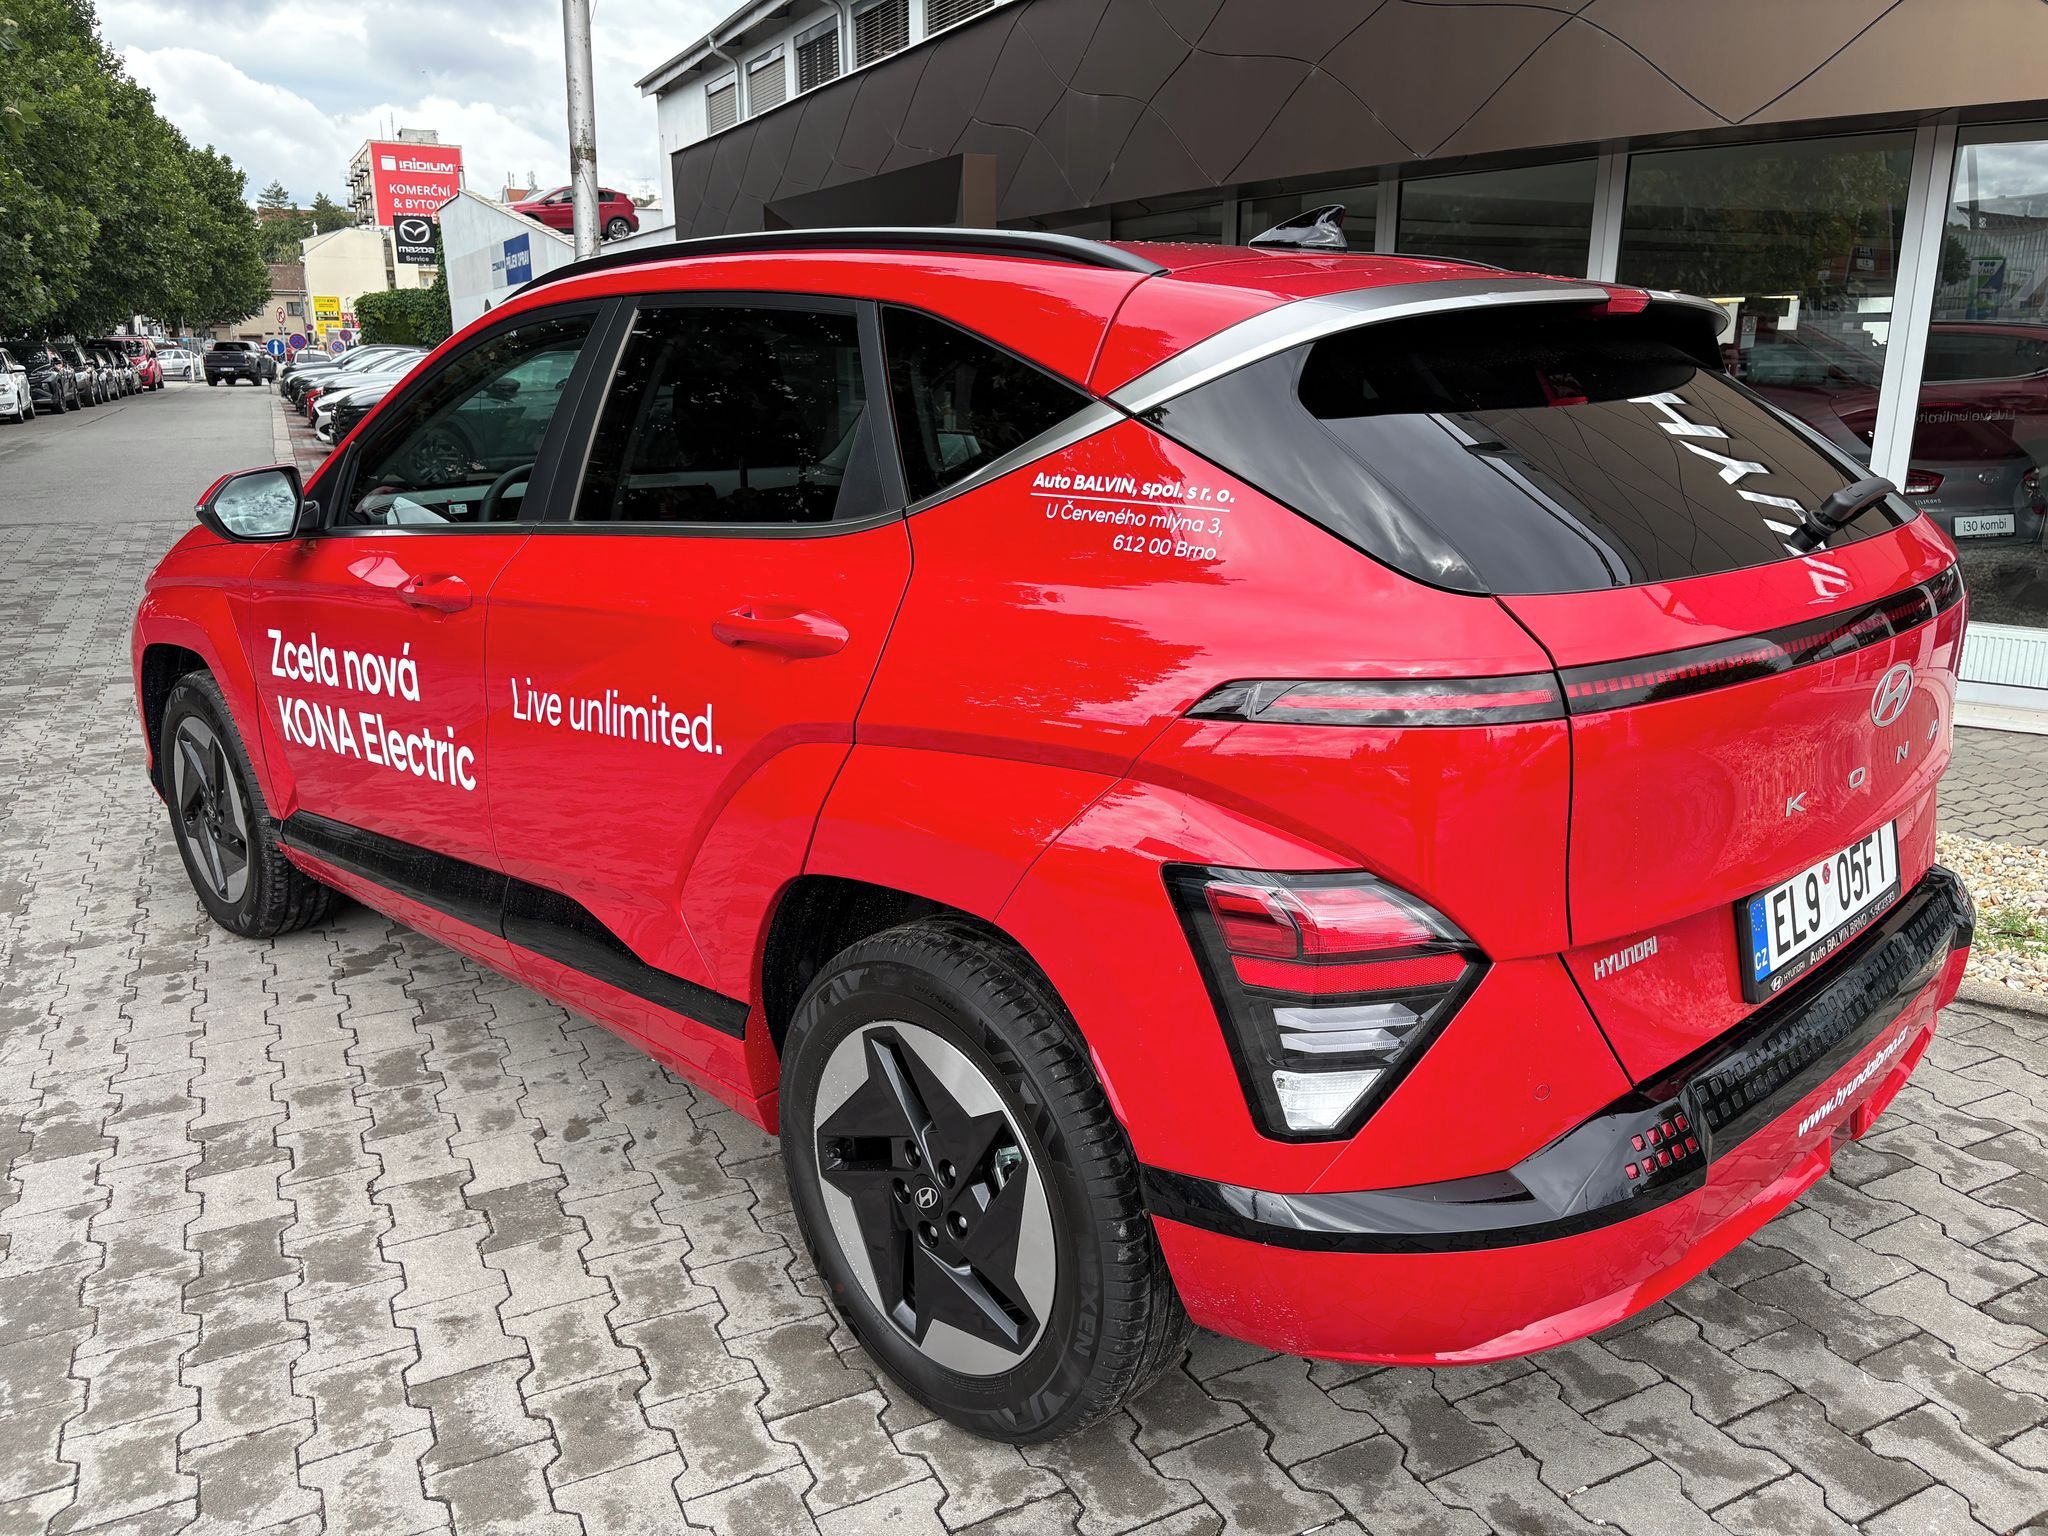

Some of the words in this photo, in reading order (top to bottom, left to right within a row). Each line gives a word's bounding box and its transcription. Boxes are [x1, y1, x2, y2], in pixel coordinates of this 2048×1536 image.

[389, 184, 451, 197] KOMERČNÍ
[394, 198, 402, 208] &
[405, 199, 446, 210] BYTOV
[398, 246, 435, 254] mazda
[1032, 472, 1070, 490] Auto
[1073, 475, 1137, 498] BALVIN,
[1141, 482, 1183, 498] spol.
[1187, 487, 1197, 500] s
[1200, 487, 1211, 500] r.
[1216, 489, 1235, 503] o.
[1046, 503, 1058, 519] U
[1061, 500, 1146, 527] Červeného
[1149, 510, 1204, 533] mlýna
[1207, 517, 1223, 538] 3,
[1963, 521, 1978, 533] i30
[1980, 518, 2007, 531] kombi
[1113, 535, 1145, 553] 612
[1148, 539, 1171, 555] 00
[1174, 542, 1217, 561] Brno
[267, 628, 340, 687] Zcela
[345, 642, 421, 702] nová
[511, 677, 562, 726] Live
[570, 689, 723, 755] unlimited.
[277, 695, 361, 759] KONA
[358, 711, 477, 791] Electric
[1773, 873, 1821, 957] EL9
[1810, 945, 1826, 965] Auto
[1826, 926, 1849, 953] BALVIN
[1850, 914, 1868, 936] BRNO
[1593, 935, 1659, 981] HYUNDAI
[1755, 947, 1768, 971] CZ
